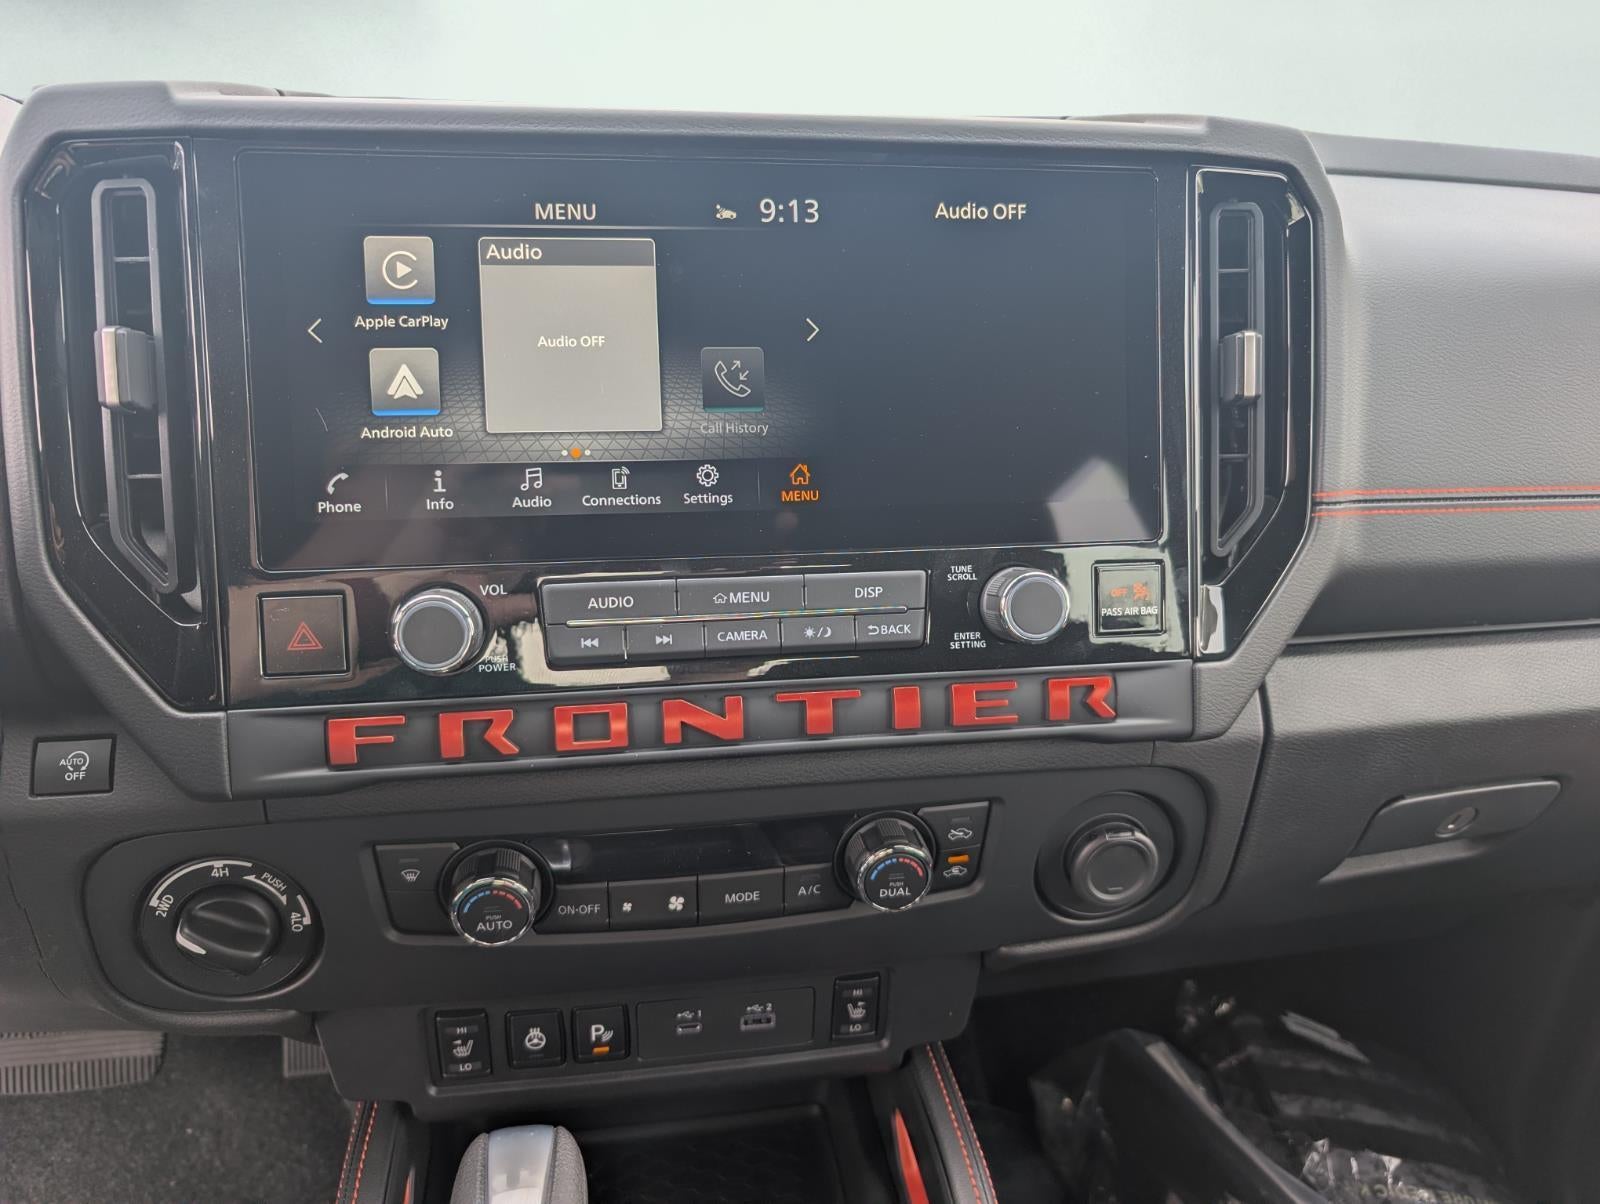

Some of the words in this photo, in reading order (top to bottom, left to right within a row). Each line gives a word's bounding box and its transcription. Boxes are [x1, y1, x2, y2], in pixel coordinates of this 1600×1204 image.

[535, 203, 597, 220] MENU
[760, 198, 819, 223] 9:13
[935, 202, 988, 220] Audio
[993, 203, 1027, 220] OFF
[486, 243, 543, 261] Audio
[355, 314, 396, 330] Apple
[399, 314, 449, 330] CarPlay
[537, 335, 577, 347] Audio
[580, 335, 605, 347] OFF
[361, 425, 415, 439] Android
[420, 425, 453, 438] Auto
[700, 422, 722, 433] Call
[726, 421, 768, 436] History
[582, 493, 661, 507] Connections
[684, 491, 733, 506] Settings
[782, 489, 819, 501] MENU
[318, 500, 362, 514] Phone
[426, 498, 454, 510] Info
[513, 495, 552, 508] Audio
[951, 565, 972, 573] TUNE
[947, 573, 977, 581] SCROLL
[480, 584, 507, 595] VOL
[855, 587, 883, 598] DISP
[1110, 587, 1127, 597] OFF
[588, 596, 634, 609] AUDIO
[730, 592, 770, 603] MENU
[1102, 607, 1123, 616] PASS
[1124, 607, 1139, 615] AIR
[1141, 606, 1158, 615] BAG
[881, 624, 911, 635] BACK
[717, 630, 768, 642] CAMERA
[954, 632, 980, 640] ENTER
[950, 640, 986, 649] SETTING
[485, 655, 508, 663] PUSH
[478, 662, 516, 672] POWER
[326, 675, 1117, 766] FRONTIER
[60, 758, 84, 766] AUTO
[65, 772, 86, 781] OFF
[211, 868, 229, 878] 4H
[261, 872, 287, 892] PUSH
[798, 884, 821, 896] A/C
[879, 887, 911, 898] DUAL
[725, 891, 760, 904] MODE
[155, 894, 174, 918] 2WD
[291, 911, 303, 932] 4LO
[476, 920, 513, 932] AUTO
[850, 1024, 861, 1032] LO
[459, 1063, 472, 1071] LO
